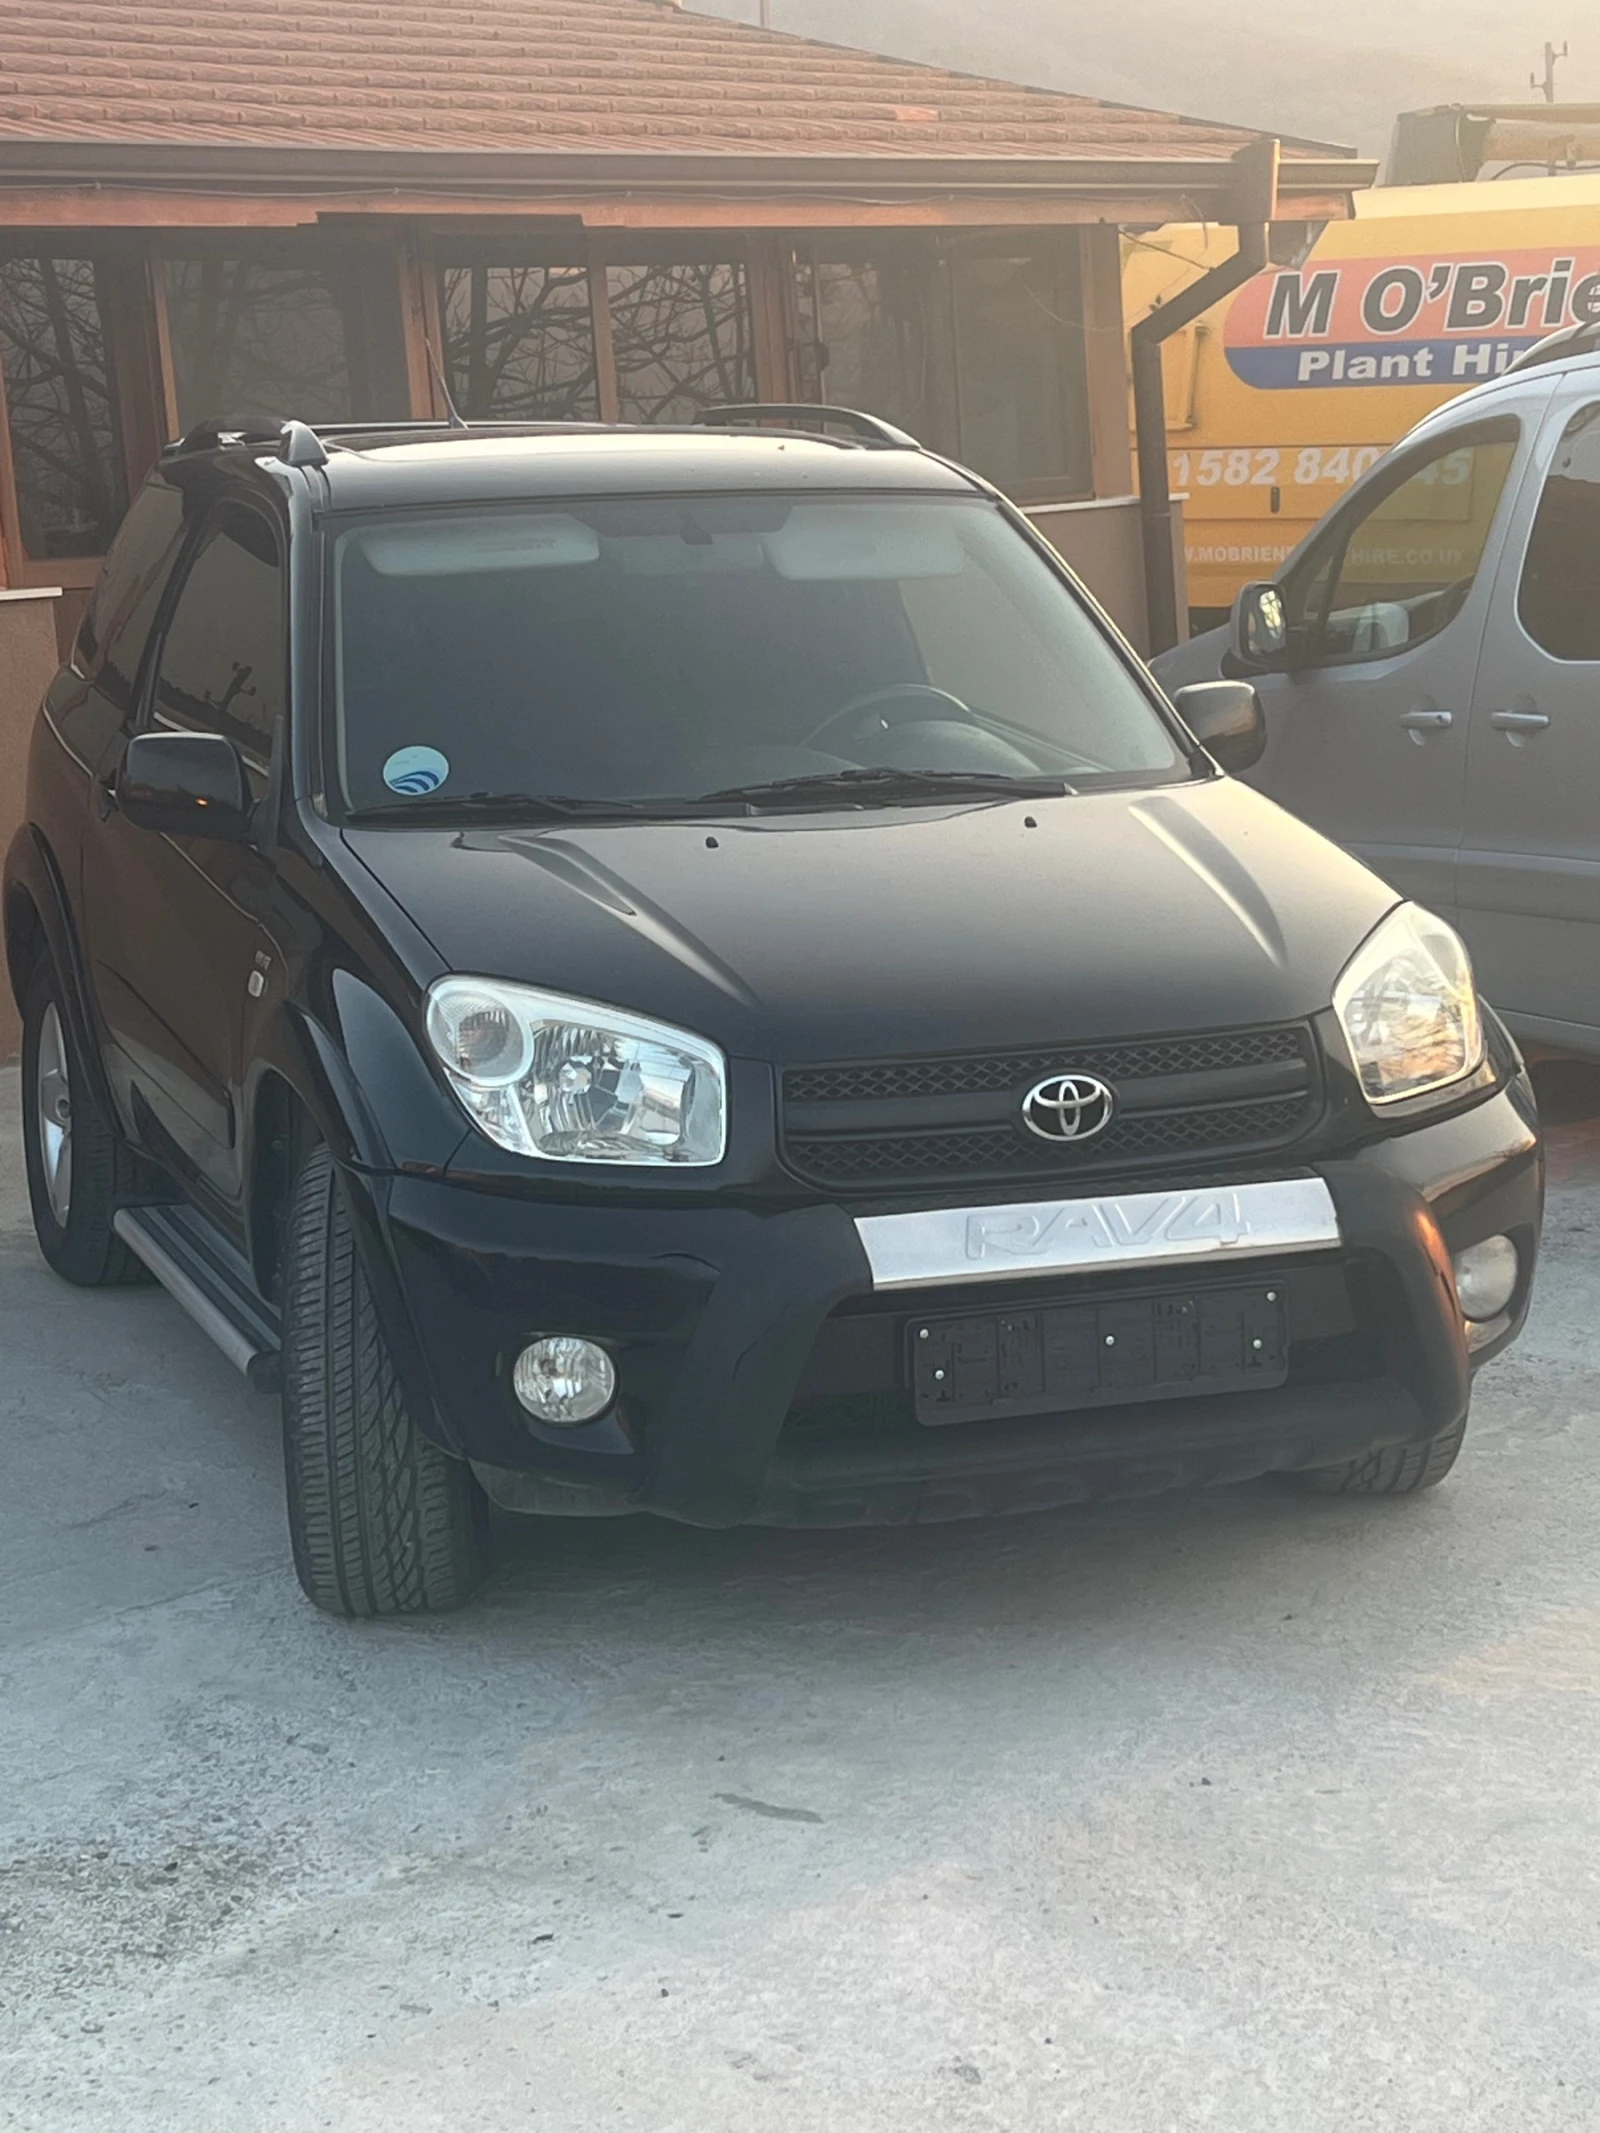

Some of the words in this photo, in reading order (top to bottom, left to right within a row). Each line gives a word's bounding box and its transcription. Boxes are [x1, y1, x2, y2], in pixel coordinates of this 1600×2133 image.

[1263, 270, 1341, 339] M
[1298, 346, 1433, 381] Plant
[966, 1193, 1250, 1259] RAV4
